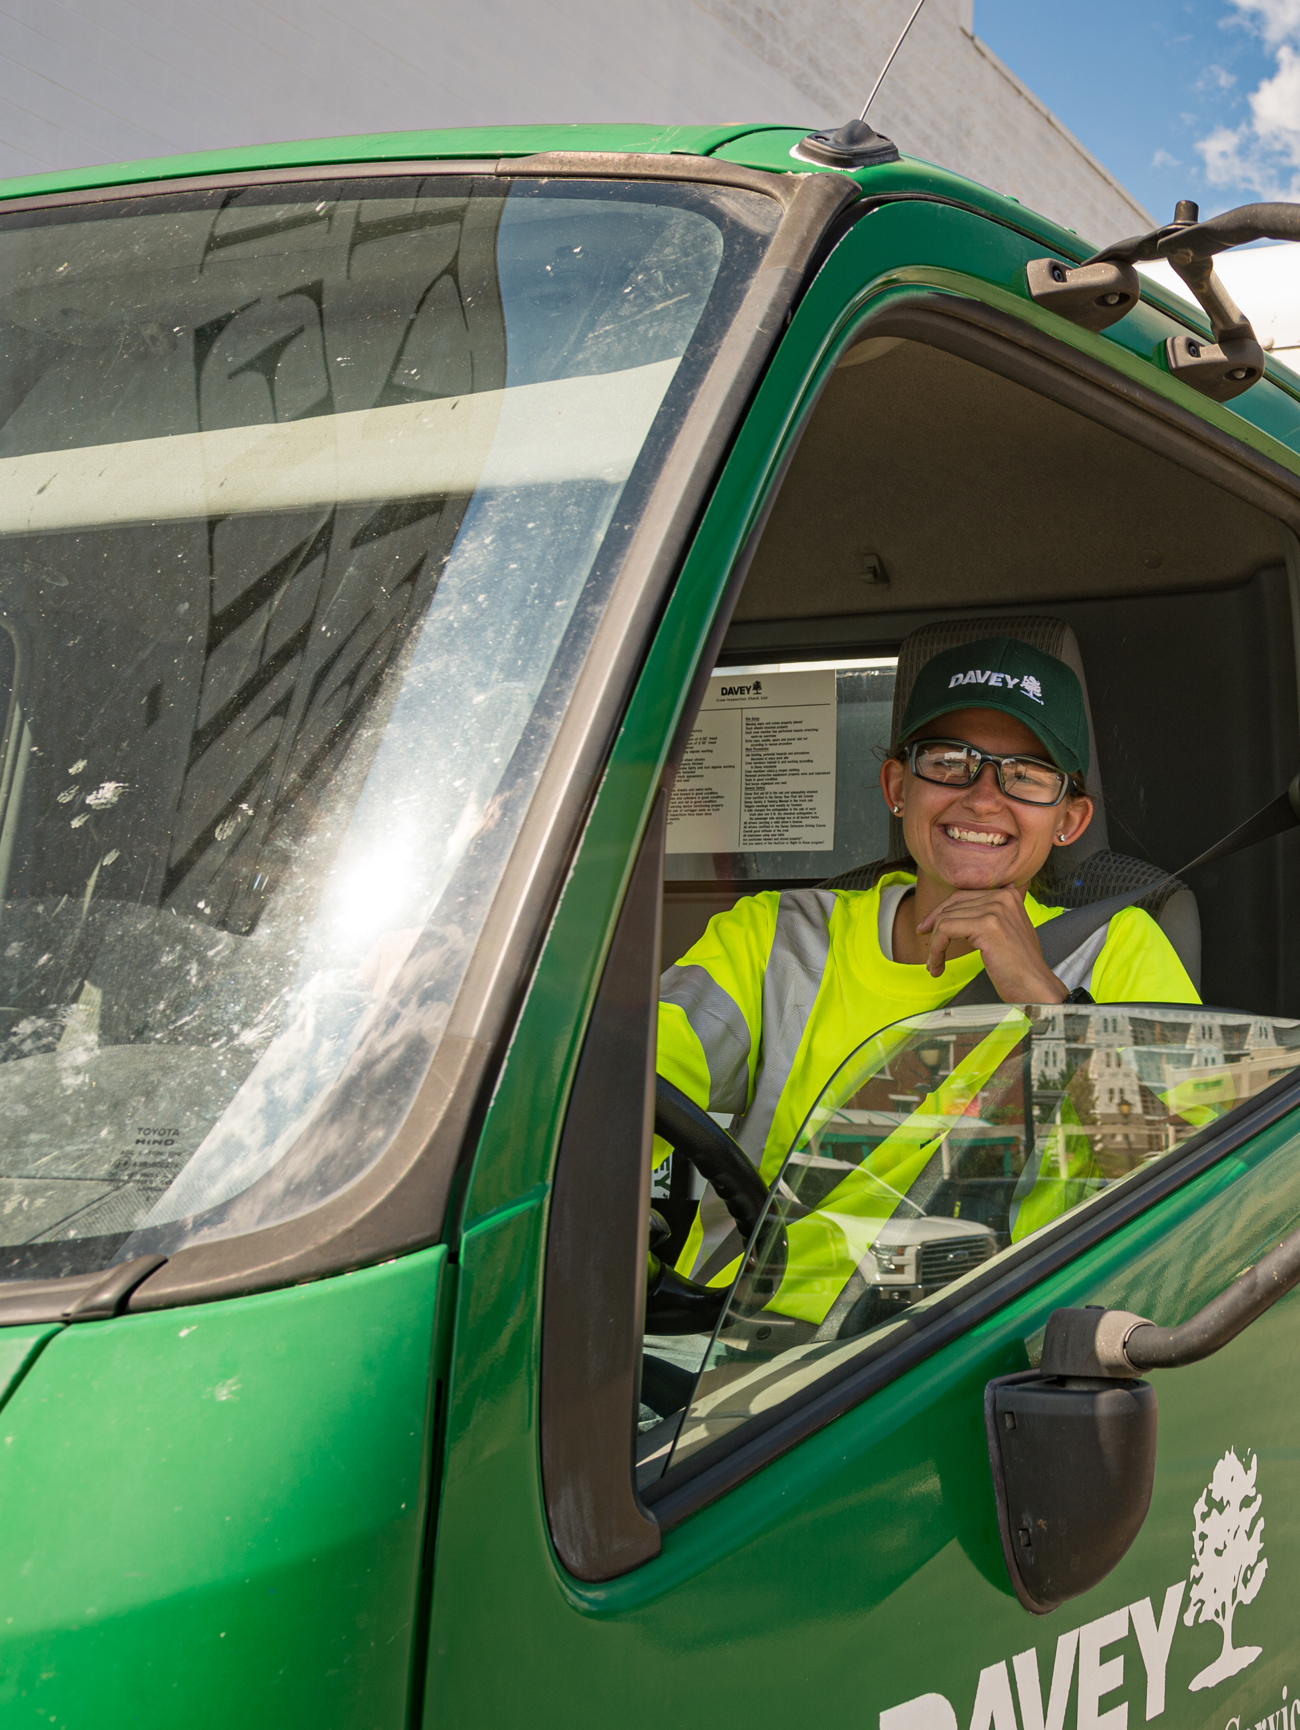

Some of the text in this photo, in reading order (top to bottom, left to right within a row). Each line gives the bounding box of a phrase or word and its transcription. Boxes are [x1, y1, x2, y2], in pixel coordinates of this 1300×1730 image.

[948, 670, 1020, 688] DAVEY
[721, 686, 752, 696] DAVEY
[138, 1127, 180, 1136] TOYOTA
